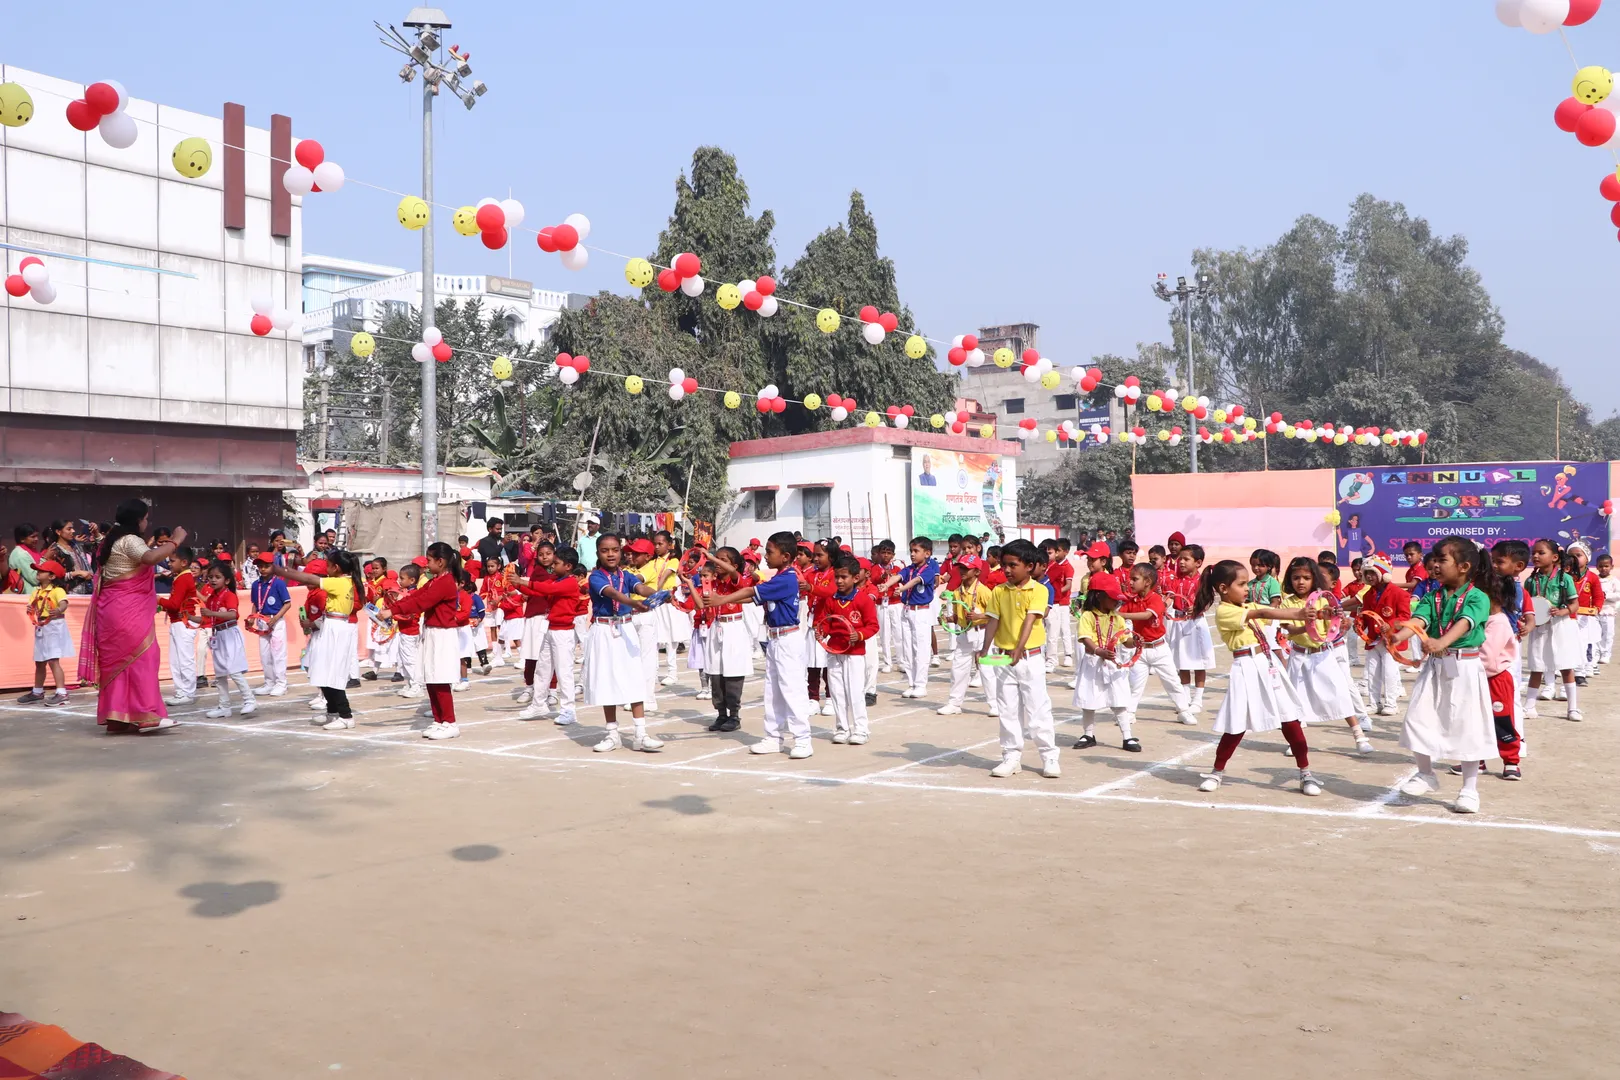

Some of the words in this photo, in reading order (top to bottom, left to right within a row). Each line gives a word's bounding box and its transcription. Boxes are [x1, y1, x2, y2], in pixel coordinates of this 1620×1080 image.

[1386, 470, 1531, 484] ANNUAL
[1398, 494, 1523, 509] SPORTS
[1433, 508, 1485, 519] DAY
[1427, 527, 1485, 537] ORGANISED
[1487, 527, 1501, 536] BY
